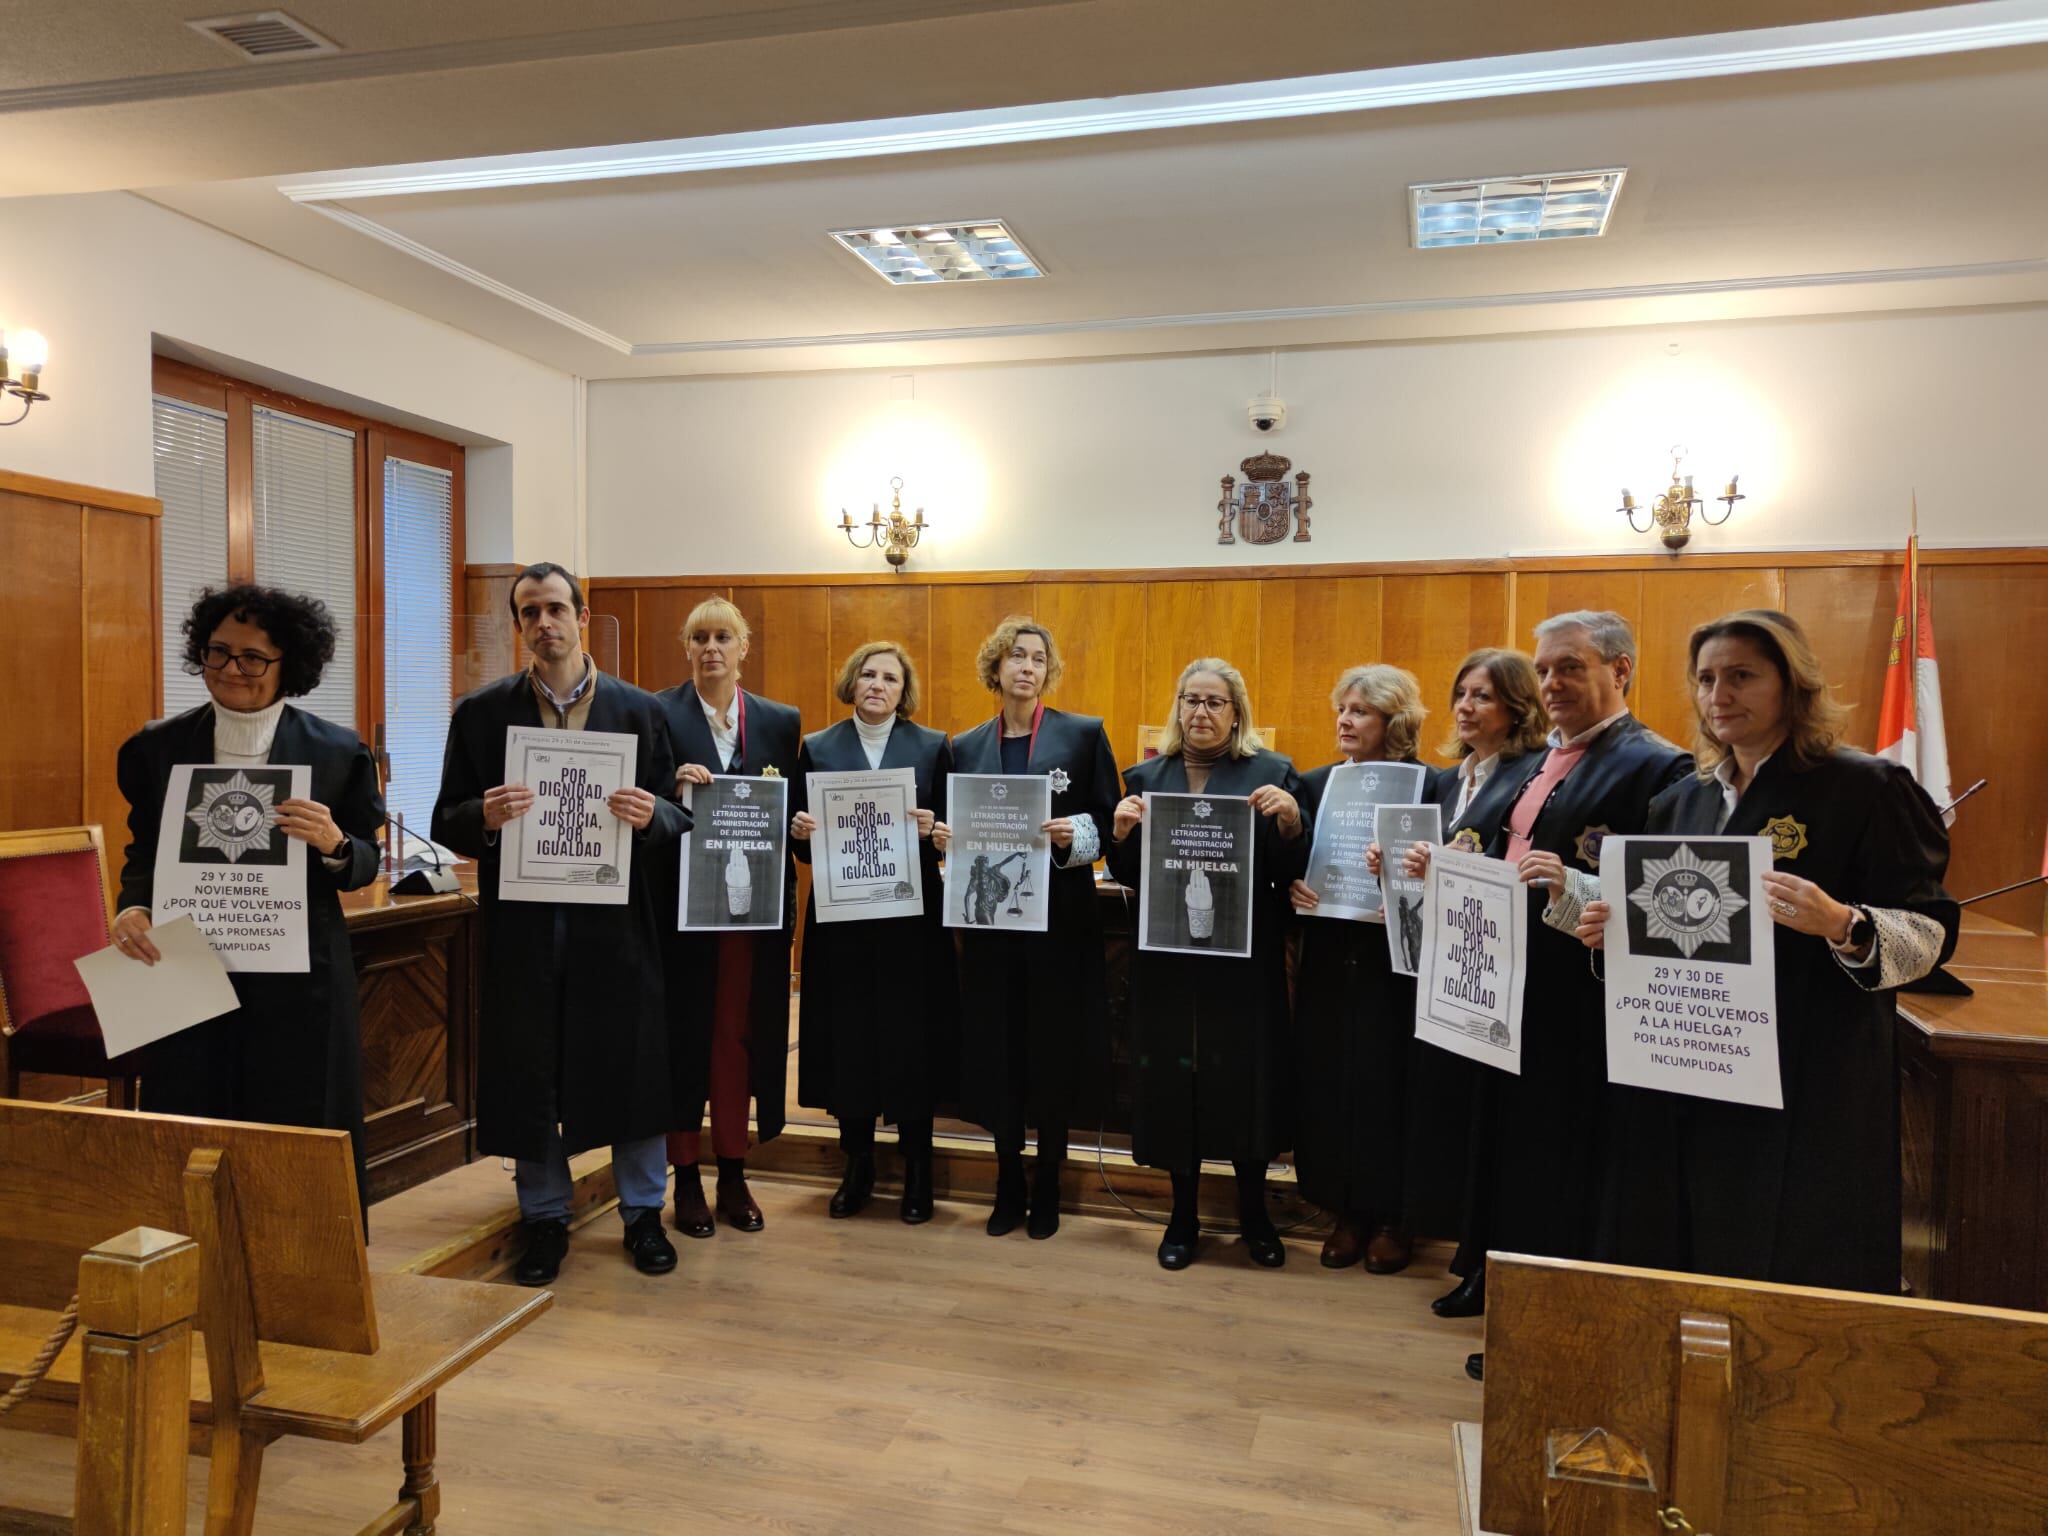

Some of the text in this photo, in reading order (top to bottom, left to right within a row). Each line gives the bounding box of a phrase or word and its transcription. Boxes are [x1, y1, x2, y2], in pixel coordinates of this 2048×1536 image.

[562, 768, 586, 783] POR
[539, 781, 607, 802] DIGNIDAD,
[560, 798, 584, 812] POR
[854, 801, 876, 815] POR
[539, 811, 602, 831] JUSTICIA,
[838, 812, 895, 828] DIGNIDAD,
[558, 827, 582, 842] POR
[856, 826, 878, 840] POR
[1171, 829, 1209, 837] LETRADOS
[537, 840, 601, 857] IGUALDAD
[706, 840, 772, 850] EN HUELGA
[842, 838, 894, 854] JUSTICIA,
[967, 841, 1032, 852] EN HUELGA
[1171, 839, 1232, 848] ADMINISTRACIÓN
[858, 852, 879, 865] POR
[1191, 850, 1224, 858] JUSTICIA
[842, 863, 896, 880] IGUALDAD
[1165, 859, 1238, 872] EN HUELGA
[201, 872, 264, 882] 29 Y 30 DE
[195, 885, 269, 896] NOVIEMBRE
[163, 897, 302, 910] ¿POR QUÉ VOLVEMOS
[1464, 896, 1483, 916] POR
[199, 913, 214, 922] LA
[219, 914, 279, 922] HUELGA?
[227, 928, 286, 936] PROMESAS
[1448, 909, 1500, 943] DIGNIDAD,
[1463, 930, 1483, 951] POR
[1448, 944, 1498, 978] JUSTICIA,
[1461, 963, 1481, 986] POR
[1654, 967, 1724, 984] 29 Y 30 DE
[1444, 976, 1495, 1010] IGUALDAD
[1648, 983, 1730, 1002] NOVIEMBRE
[1616, 996, 1769, 1024] ¿POR QUÉ VOLVEMOS
[1640, 1016, 1742, 1038] A LA HUELGA?
[1634, 1032, 1750, 1057] POR LAS PROMESAS
[1651, 1053, 1733, 1074] INCUMPLIDAS
